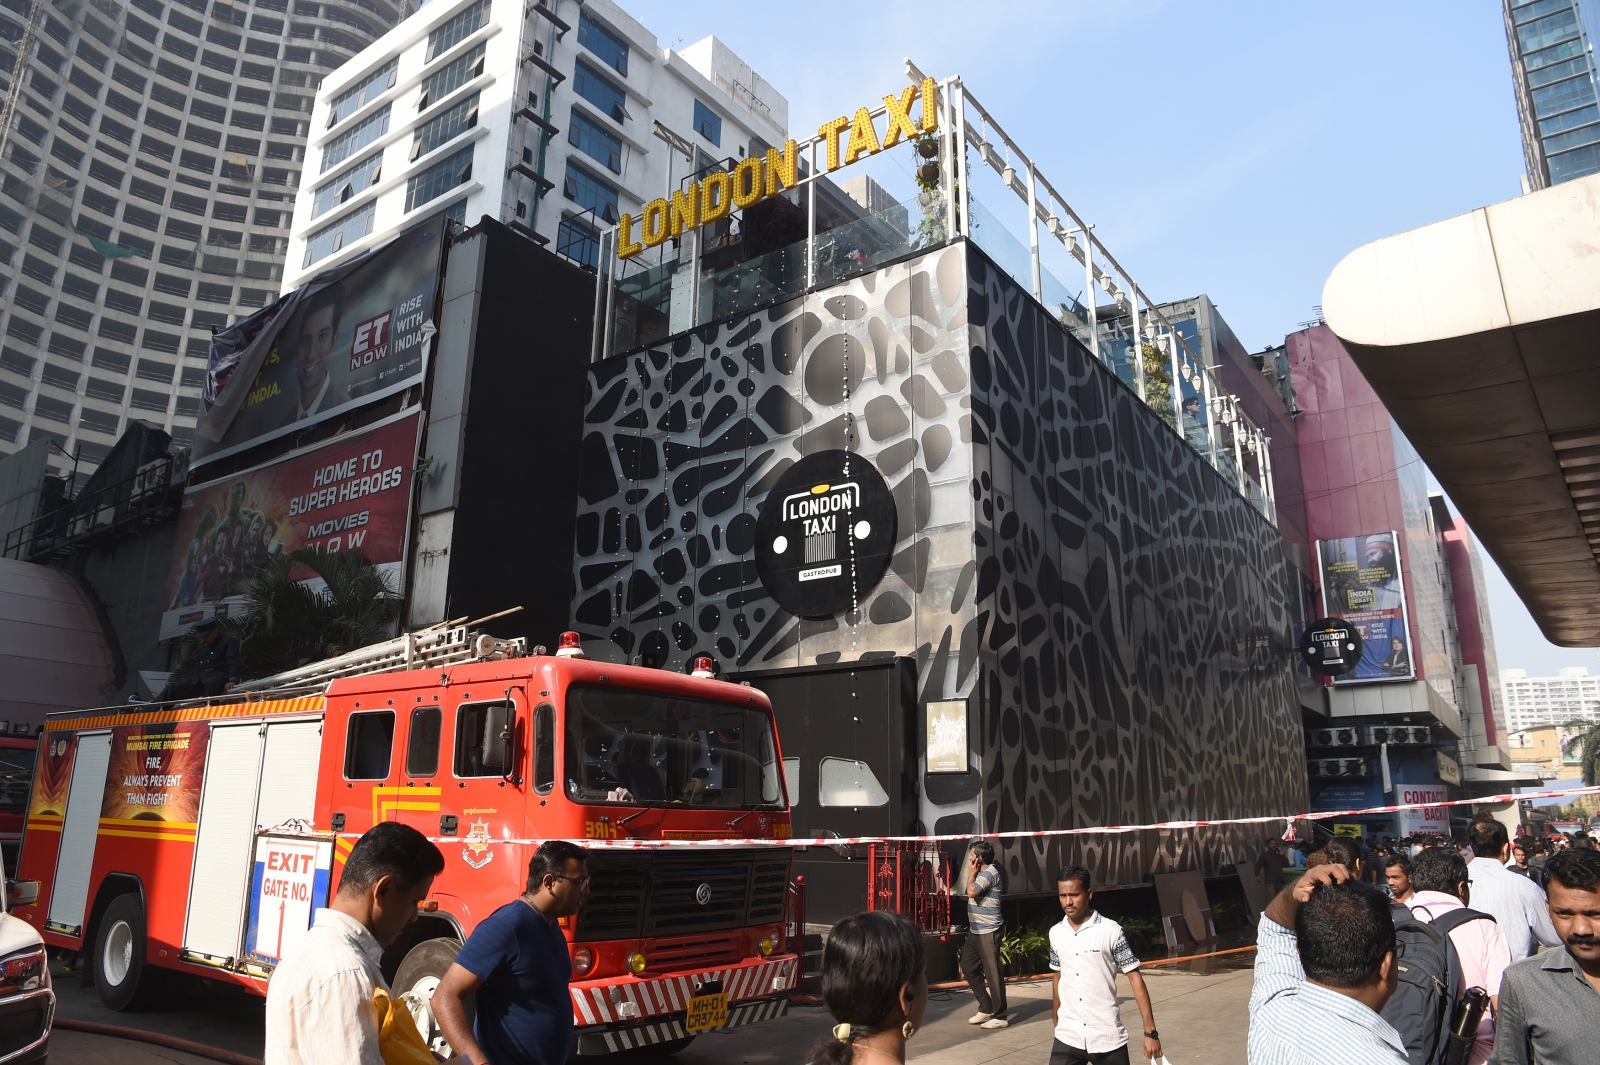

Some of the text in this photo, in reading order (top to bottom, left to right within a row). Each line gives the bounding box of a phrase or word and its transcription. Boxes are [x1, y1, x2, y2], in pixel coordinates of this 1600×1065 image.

[617, 76, 938, 261] LONDON TAXI
[399, 294, 423, 316] RISE
[396, 310, 424, 334] WITH
[353, 314, 390, 355] ET
[394, 329, 422, 354] INDIA
[350, 344, 388, 371] NOW
[312, 449, 383, 488] HOME TO
[289, 465, 403, 517] SUPER HEROES
[790, 492, 852, 520] LONDON
[307, 510, 370, 539] MOVIES
[803, 514, 836, 537] TAXI
[802, 568, 837, 578] GASTROPUB
[1350, 590, 1373, 598] INDIA
[1315, 632, 1346, 642] LONDON
[1322, 640, 1340, 648] TAXI
[126, 739, 190, 751] MUMBAI FIRE BRIGADE
[145, 756, 162, 770] FIRE,
[123, 774, 182, 787] ALWAYS PREVENT
[126, 792, 146, 805] THAN
[772, 823, 792, 838] FIRE
[267, 851, 314, 875] EXIT
[263, 877, 309, 902] GATE NO.
[688, 1009, 726, 1028] CR3744
